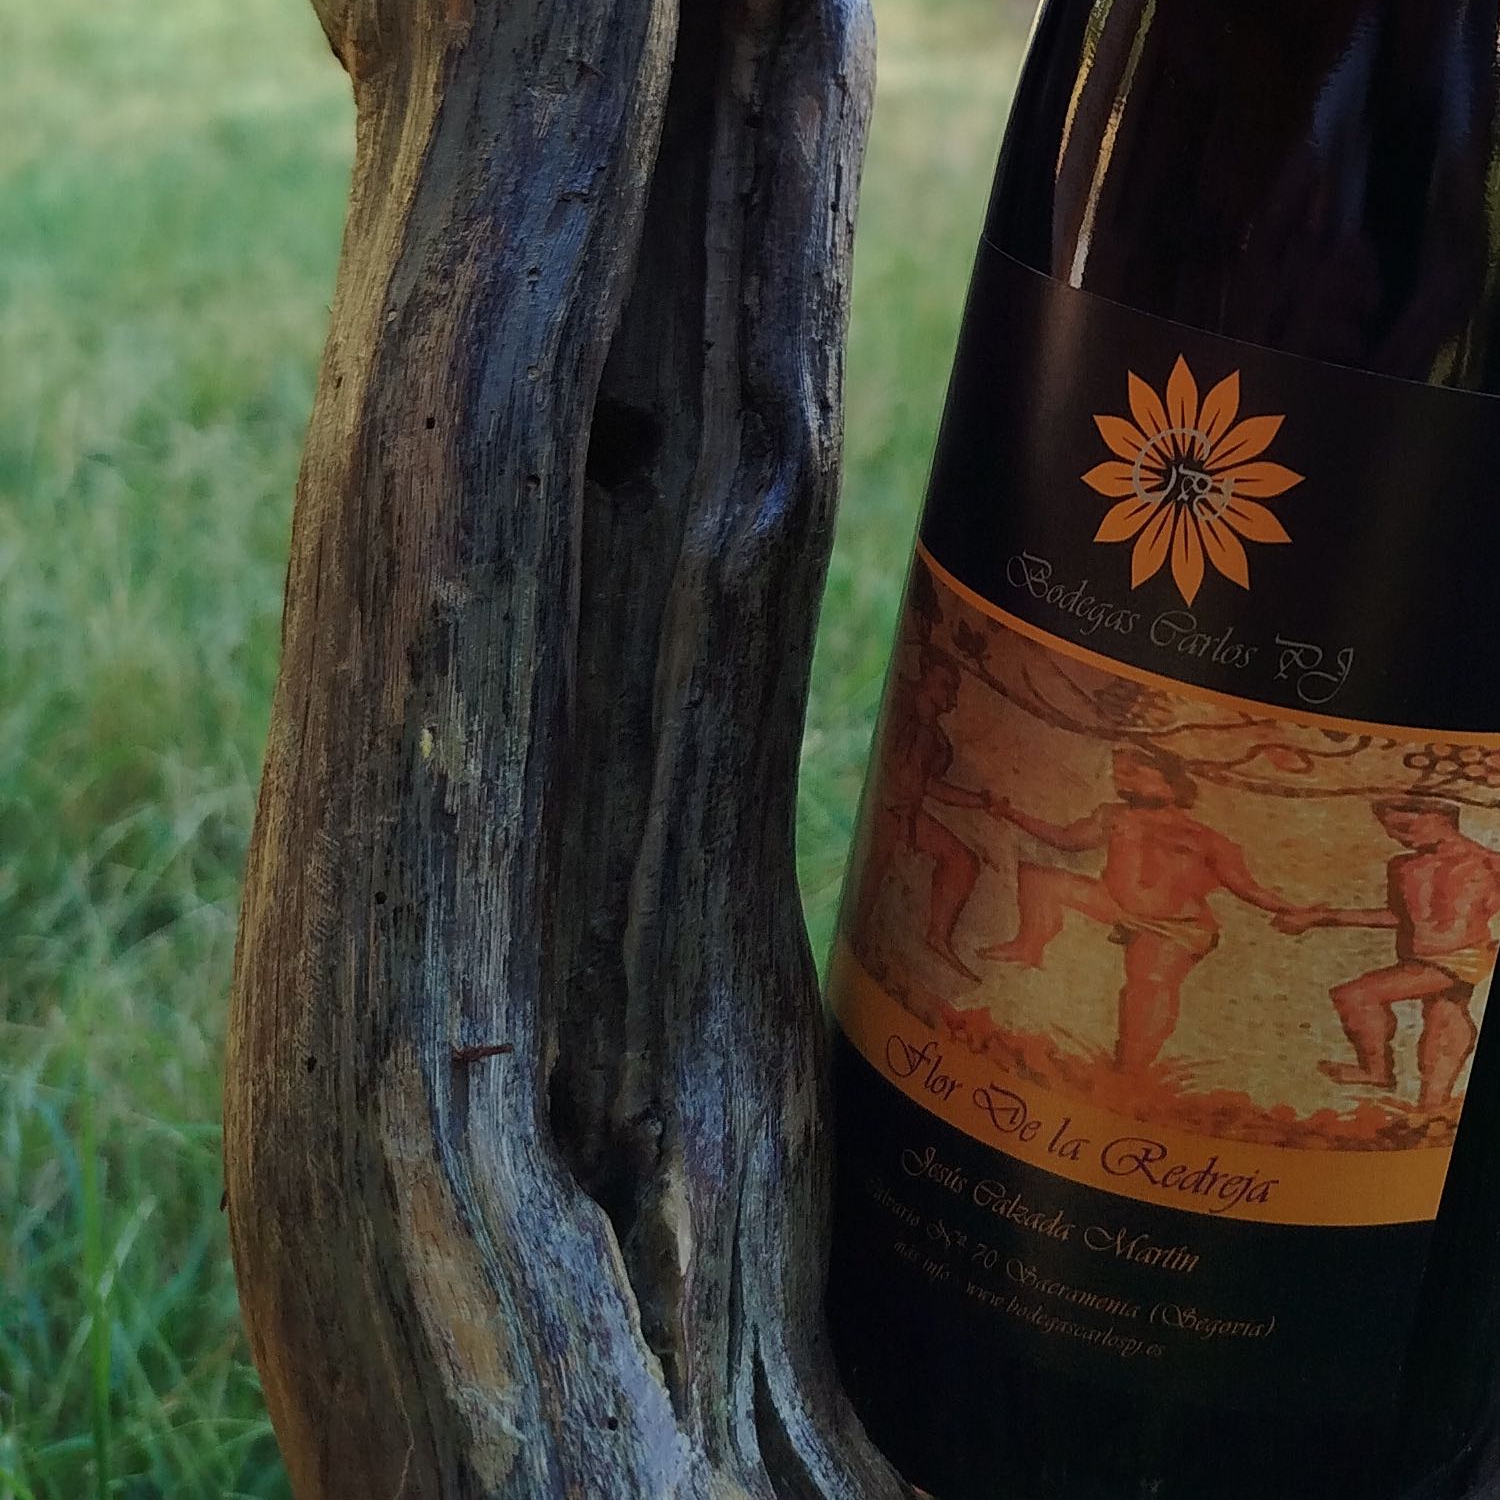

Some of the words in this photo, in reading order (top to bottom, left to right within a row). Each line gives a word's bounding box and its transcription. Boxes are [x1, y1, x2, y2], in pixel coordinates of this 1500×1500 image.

[1006, 549, 1141, 636] Bodegas
[1149, 610, 1260, 669] Carlos
[886, 1034, 963, 1102] Flor
[973, 1083, 1041, 1142] De
[1048, 1116, 1090, 1162] la
[1100, 1136, 1280, 1214] Redreja
